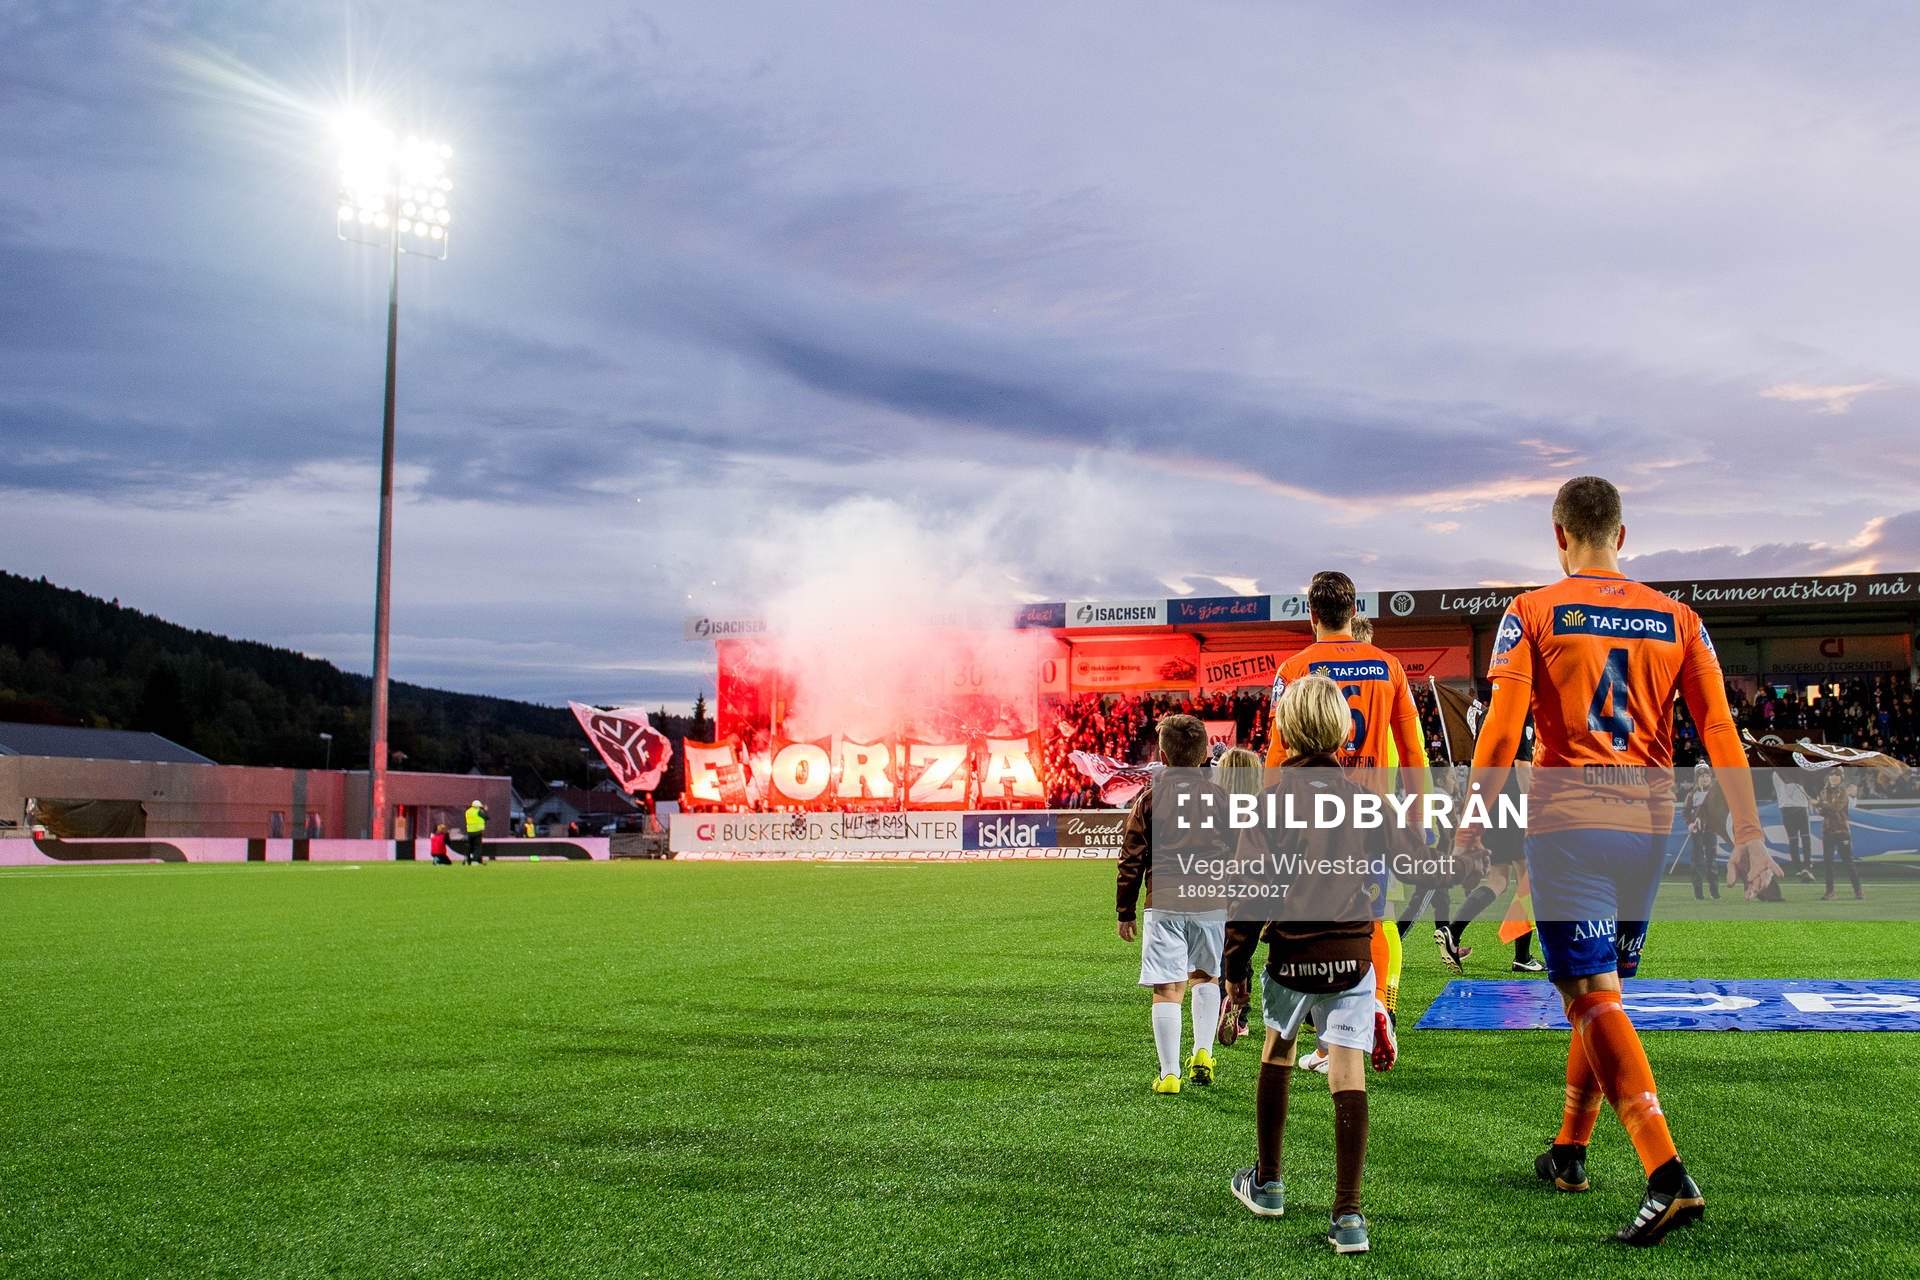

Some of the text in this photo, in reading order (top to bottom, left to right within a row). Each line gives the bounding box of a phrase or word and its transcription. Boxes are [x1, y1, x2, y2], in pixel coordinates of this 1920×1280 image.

[1440, 590, 1531, 615] Lagån
[1692, 579, 1857, 602] kameratskap
[1869, 577, 1911, 595] må
[1095, 606, 1156, 621] ISACHSEN
[1180, 601, 1257, 621] Vi gjør det!
[711, 619, 768, 634] ISACHSEN
[1590, 614, 1668, 634] TAFJORD
[1206, 654, 1276, 683] IDRETTEN
[1333, 666, 1384, 676] TAFJORD
[1588, 648, 1634, 752] 4
[1583, 763, 1649, 786] GRØNNER
[1067, 817, 1124, 836] United
